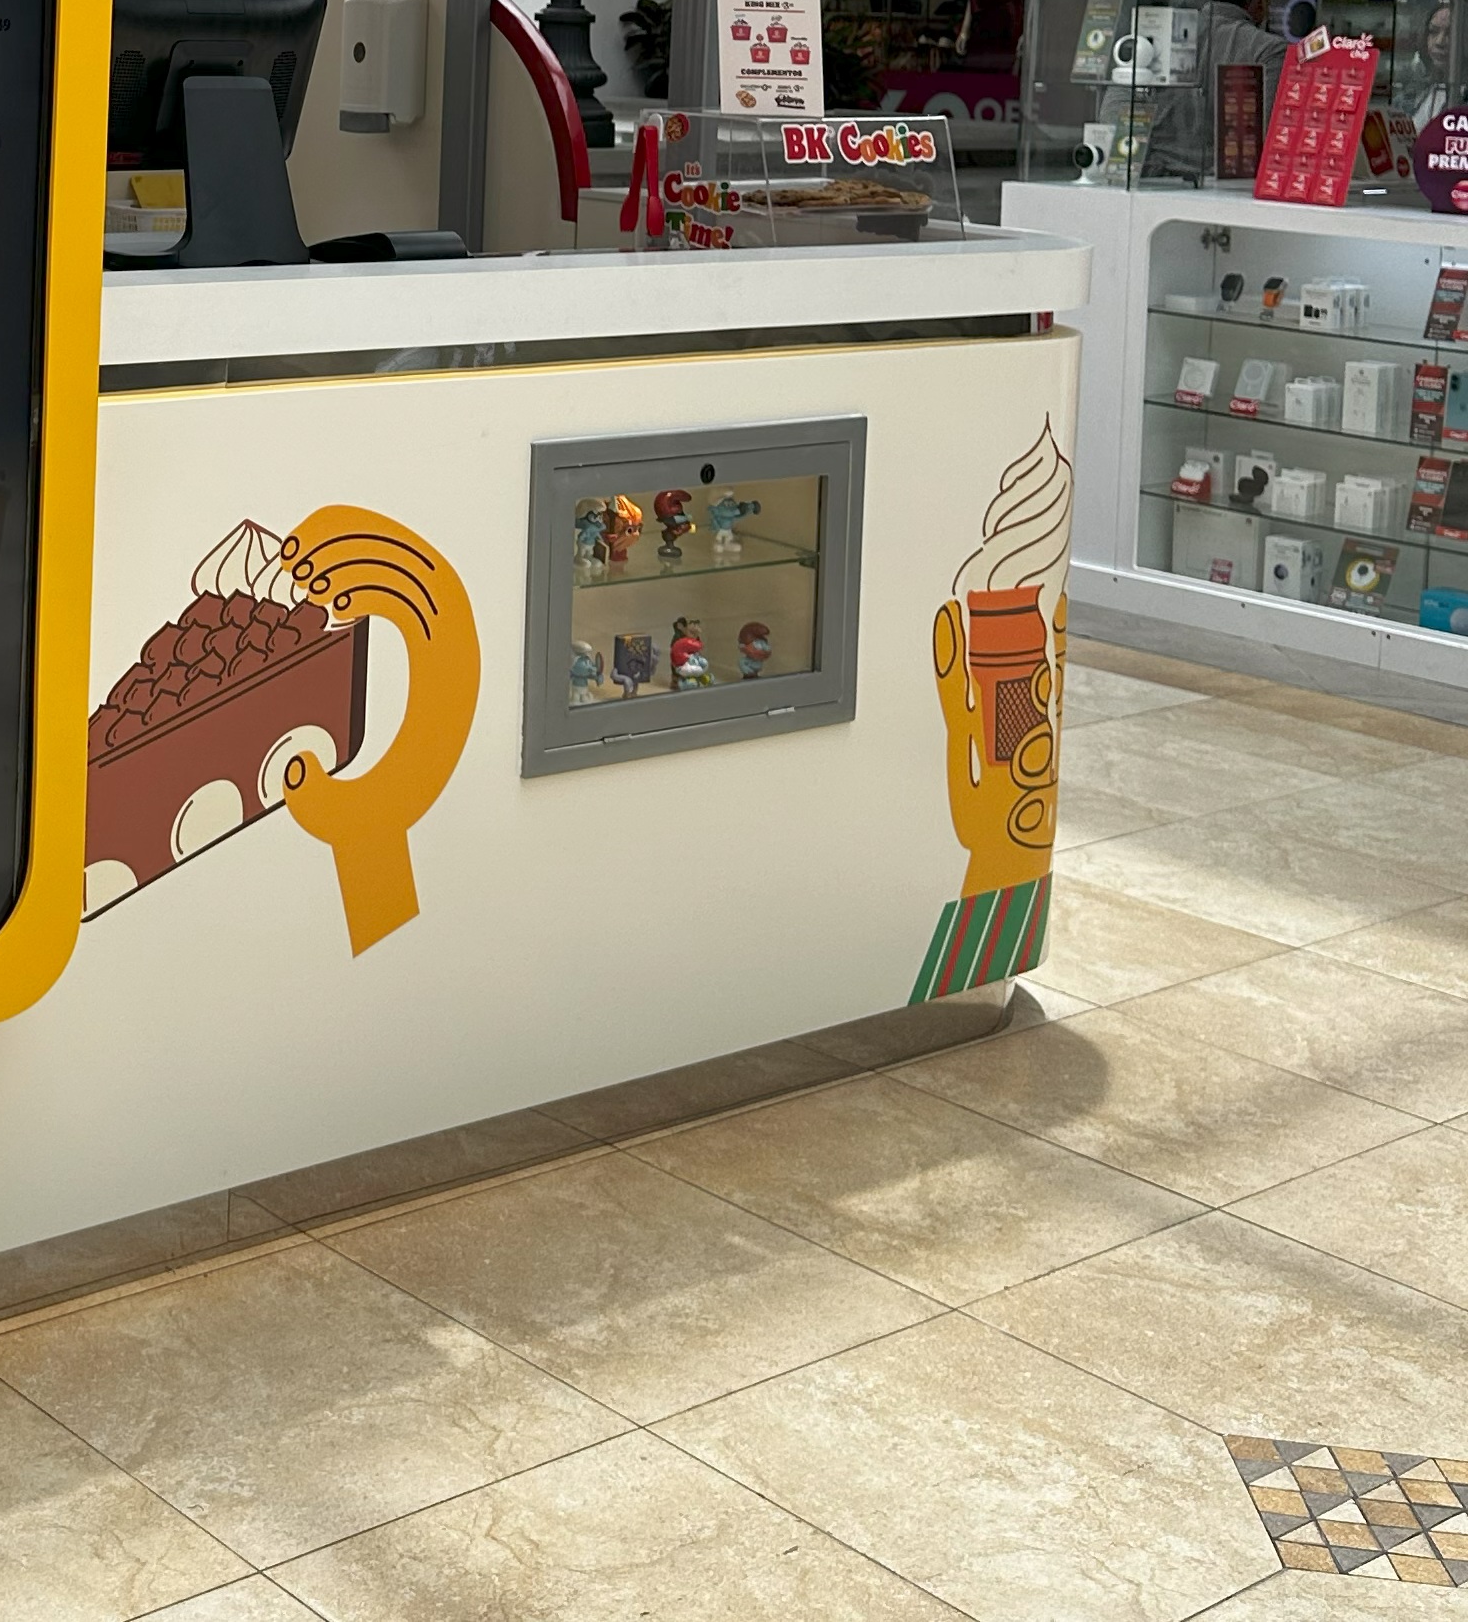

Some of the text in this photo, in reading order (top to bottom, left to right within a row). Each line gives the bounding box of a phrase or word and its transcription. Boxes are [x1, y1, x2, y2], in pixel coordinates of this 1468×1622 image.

[1331, 34, 1368, 51] Claro
[837, 121, 937, 167] Cookies
[684, 161, 703, 178] It's
[663, 170, 742, 214] Cookie
[665, 211, 735, 250] Time!
